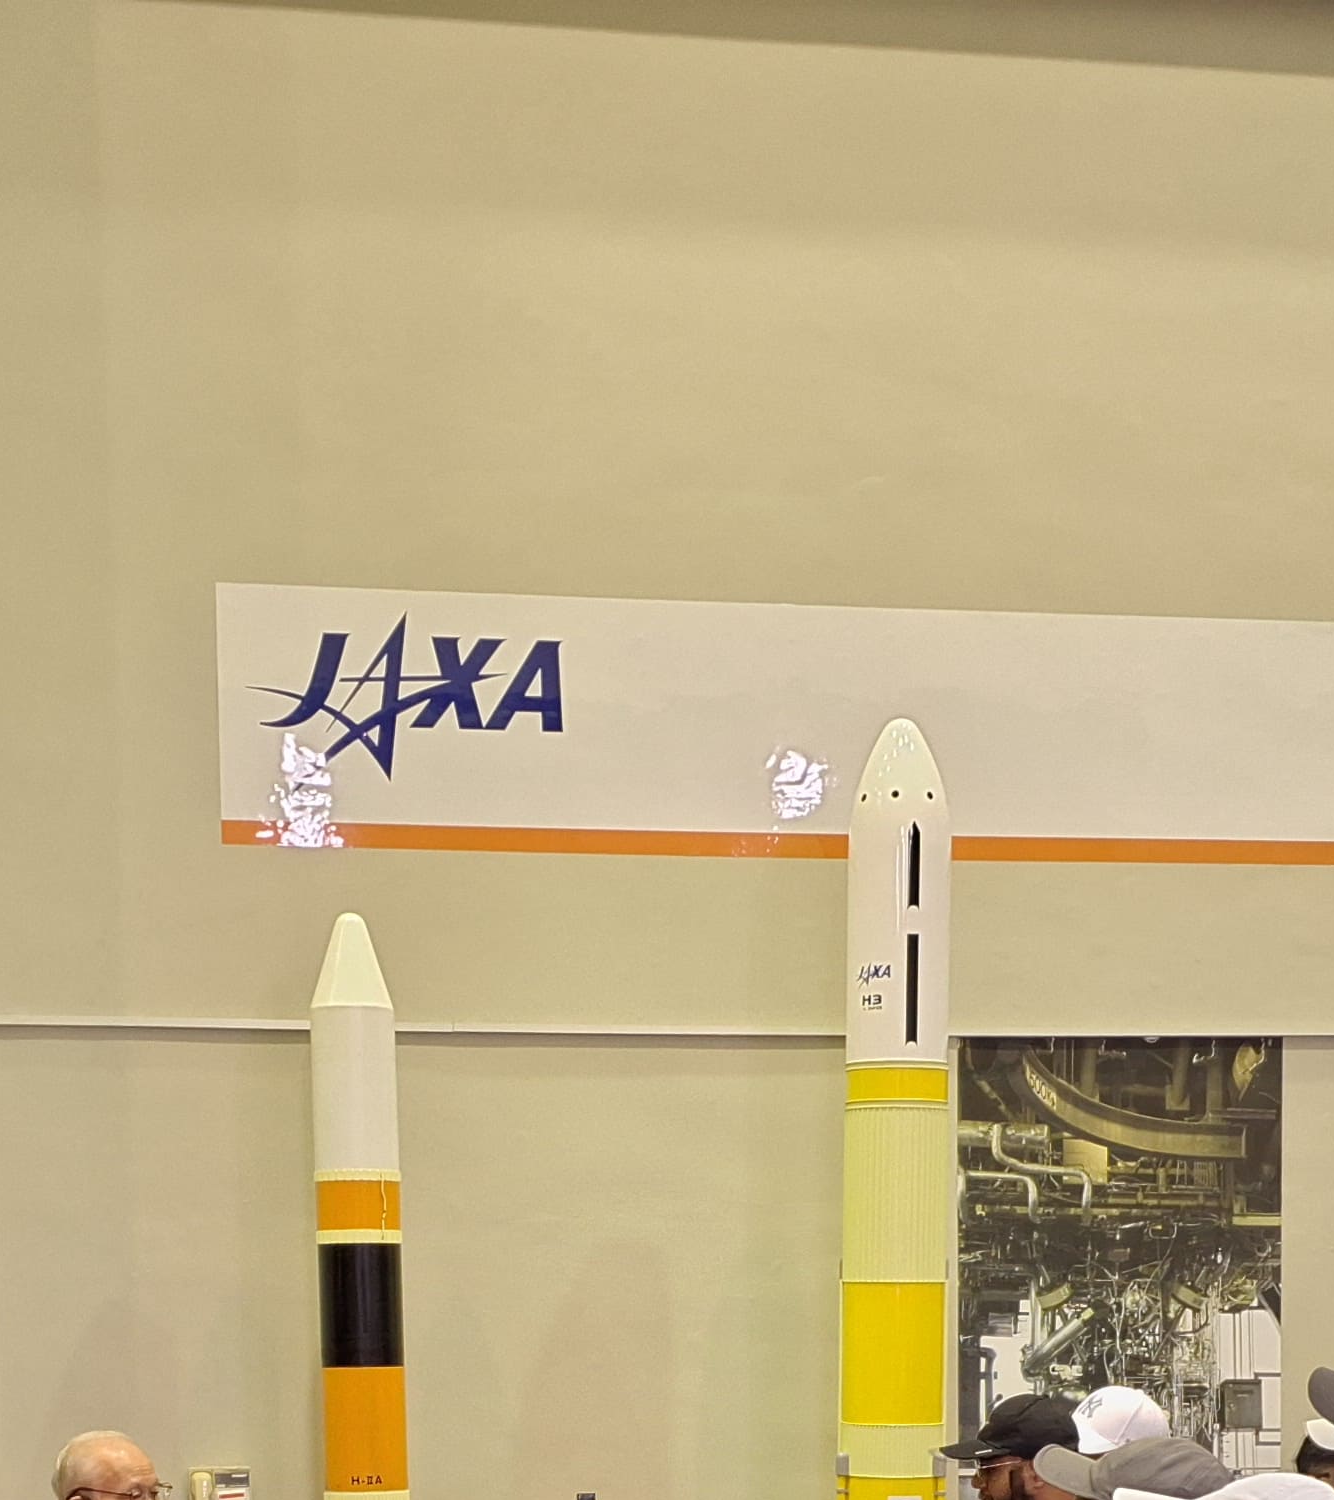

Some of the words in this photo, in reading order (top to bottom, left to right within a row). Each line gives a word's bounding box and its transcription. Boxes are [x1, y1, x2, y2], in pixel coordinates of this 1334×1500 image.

[245, 611, 564, 787] JAXA
[856, 963, 892, 989] JAXA
[862, 994, 883, 1007] H3
